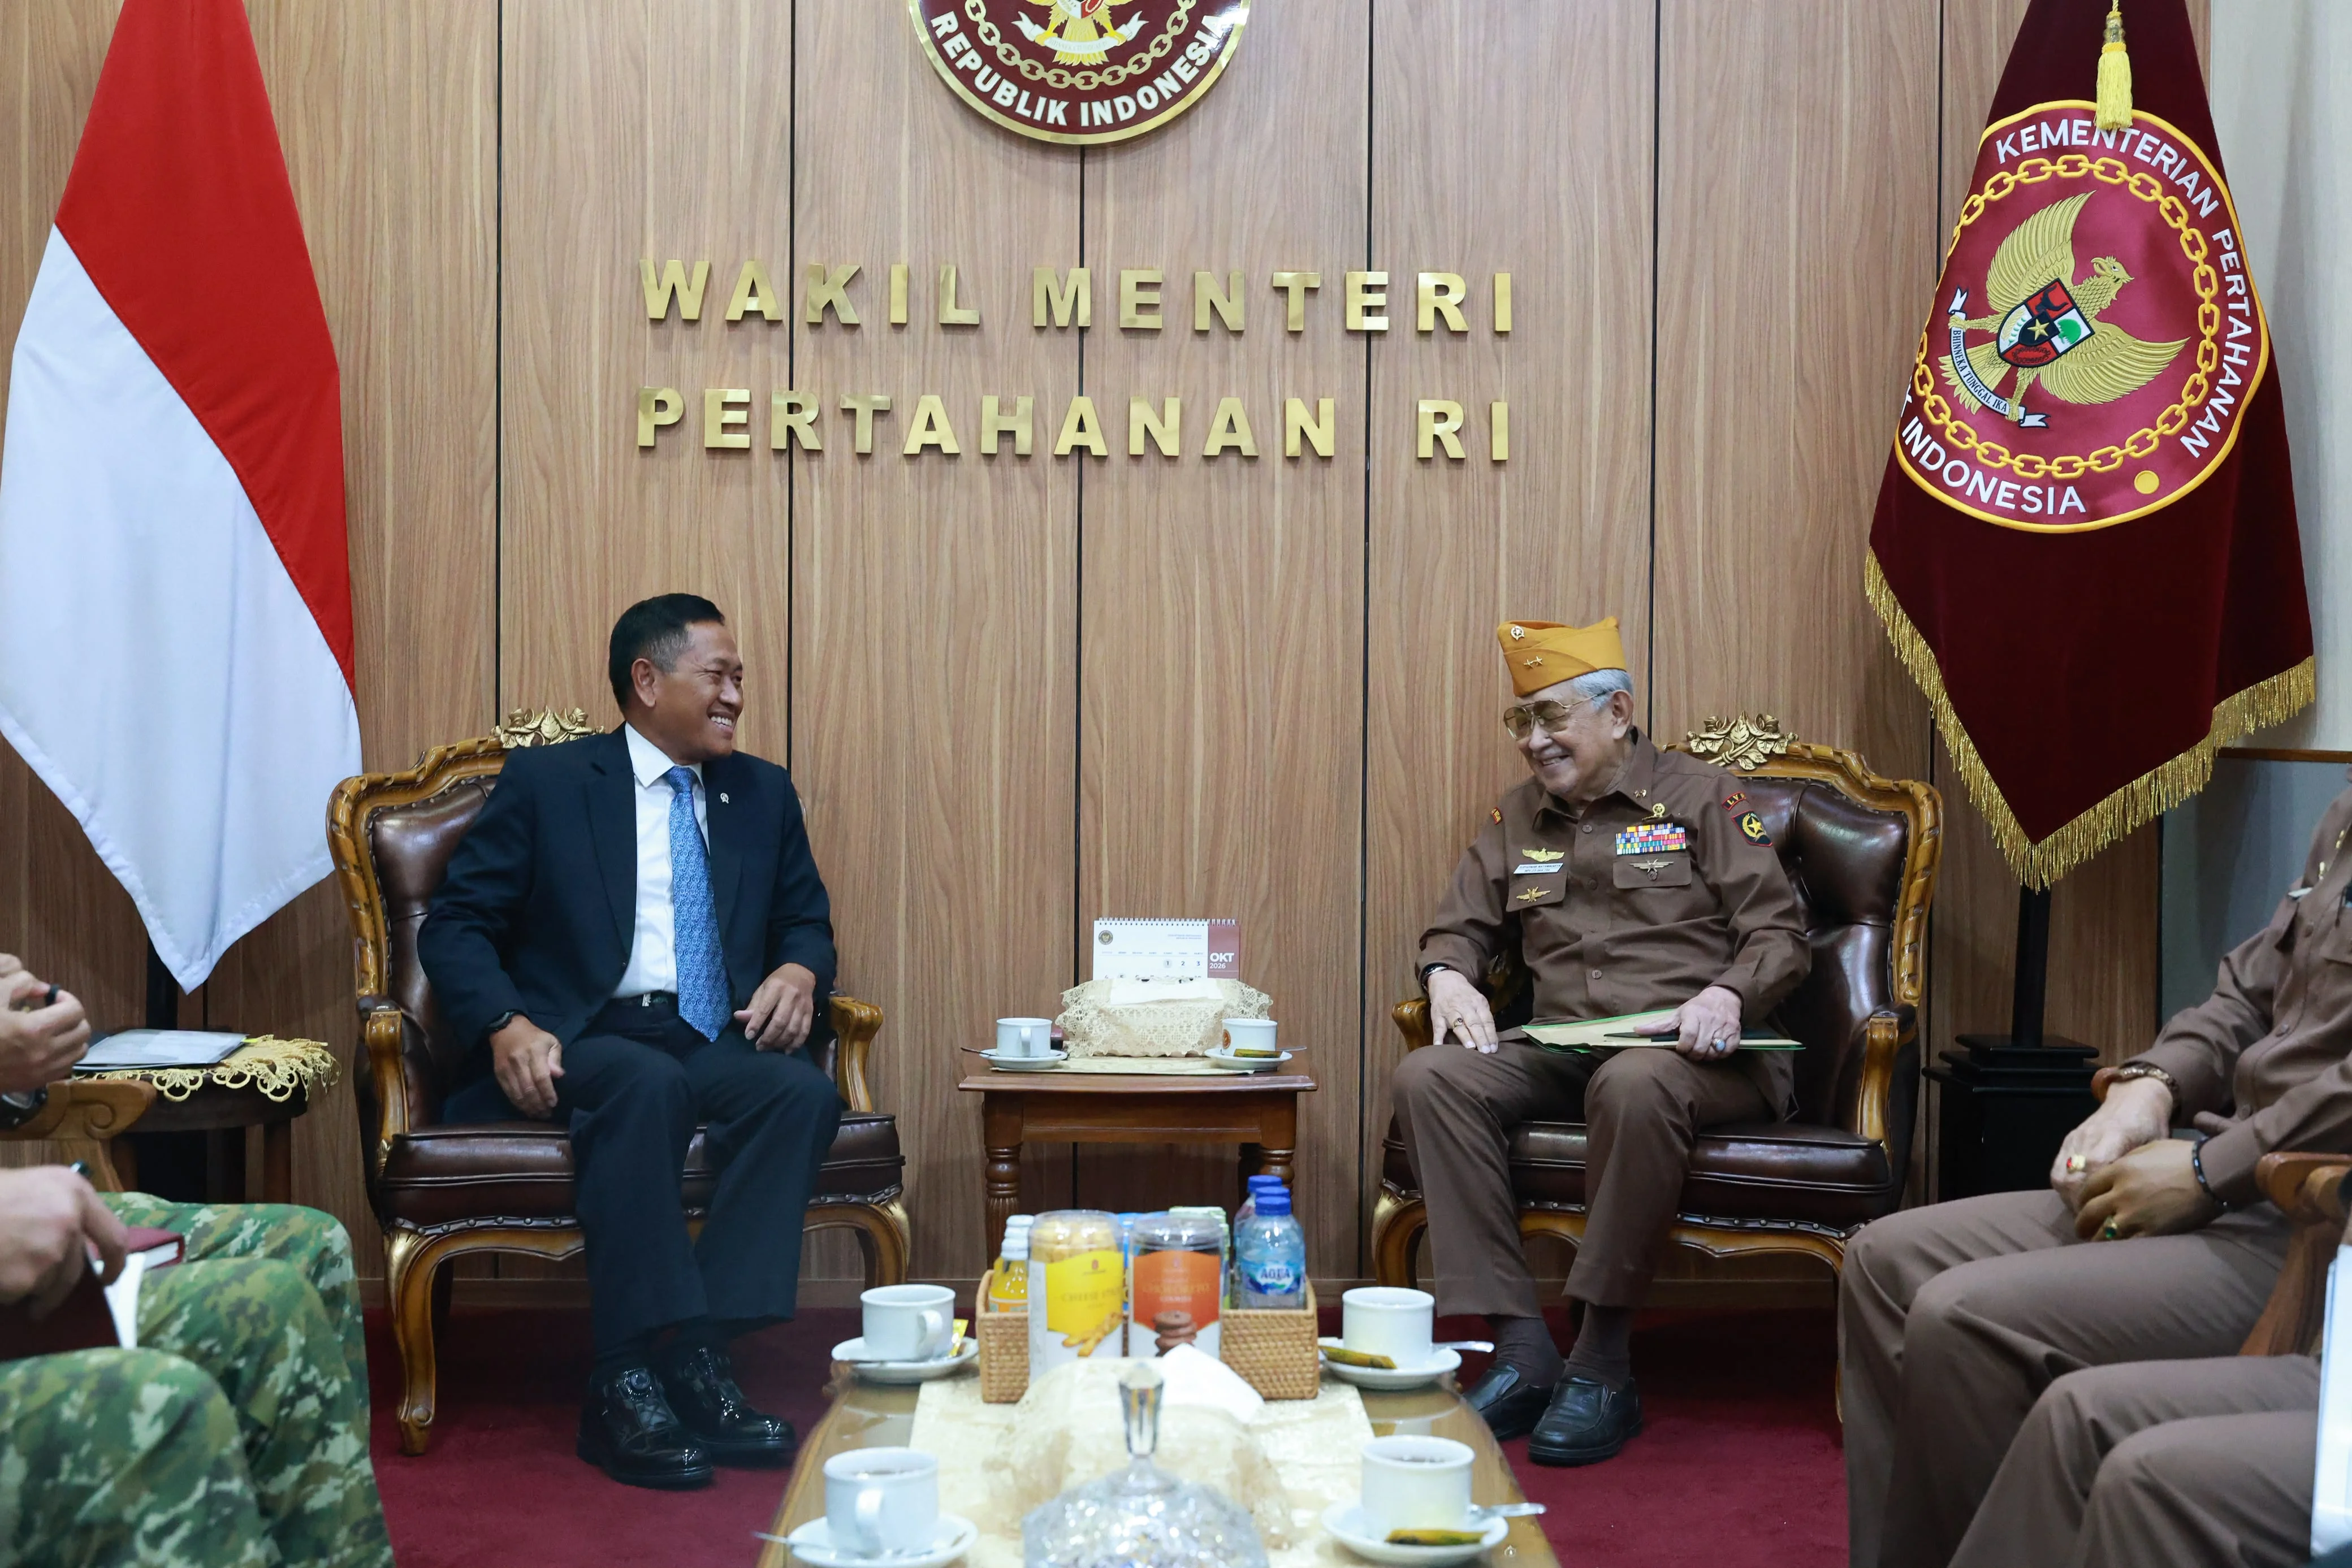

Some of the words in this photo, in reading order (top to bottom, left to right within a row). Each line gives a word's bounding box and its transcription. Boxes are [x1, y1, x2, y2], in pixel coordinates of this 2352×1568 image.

[930, 10, 1070, 127] REPUBLIK
[1081, 14, 1230, 127] INDONESIA
[639, 259, 980, 325] WAKIL
[1032, 267, 1512, 332] MENTERI
[1996, 119, 2220, 219] KEMENTERIAN
[2180, 228, 2252, 458] PERTAHANAN
[1953, 330, 1968, 372] BHINNEKA
[1963, 371, 1992, 404] TUNGGAL
[1992, 400, 2007, 412] IKA
[637, 387, 1335, 457] PERTAHANAN
[1417, 399, 1509, 461] RI
[1901, 415, 2085, 514] INDONESIA
[1210, 952, 1234, 962] OKT
